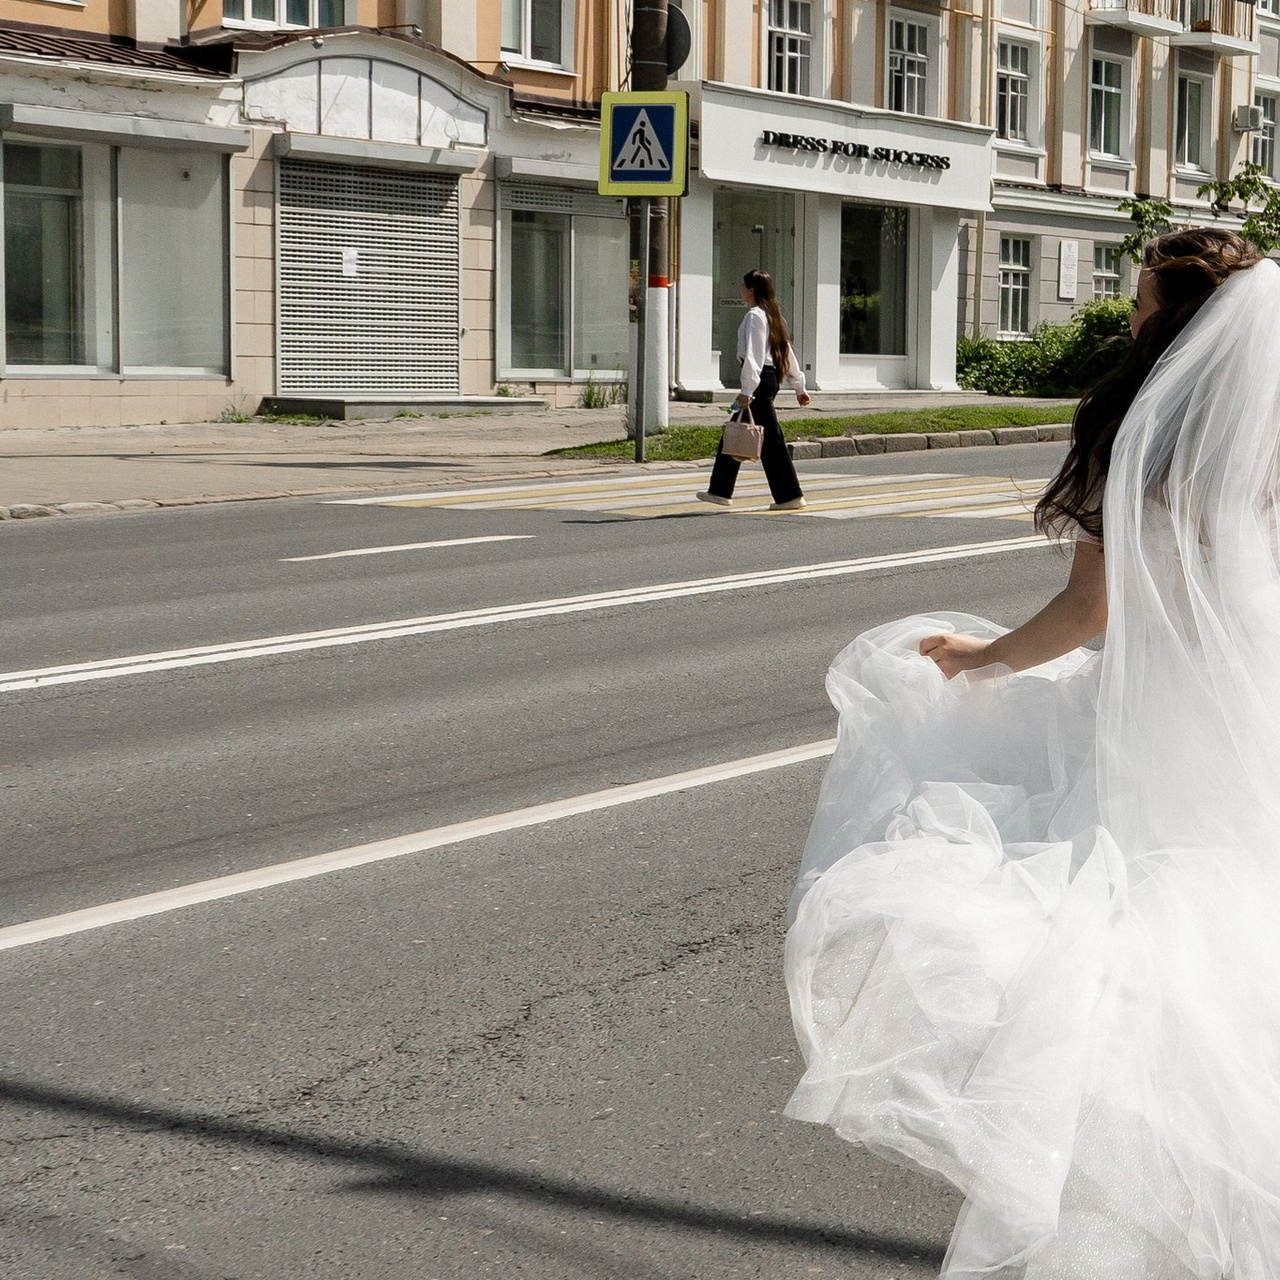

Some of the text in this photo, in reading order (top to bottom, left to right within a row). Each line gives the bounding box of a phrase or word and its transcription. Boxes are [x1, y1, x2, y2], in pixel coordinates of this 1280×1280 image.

[763, 130, 951, 169] DRESS FOR SUCCESS
